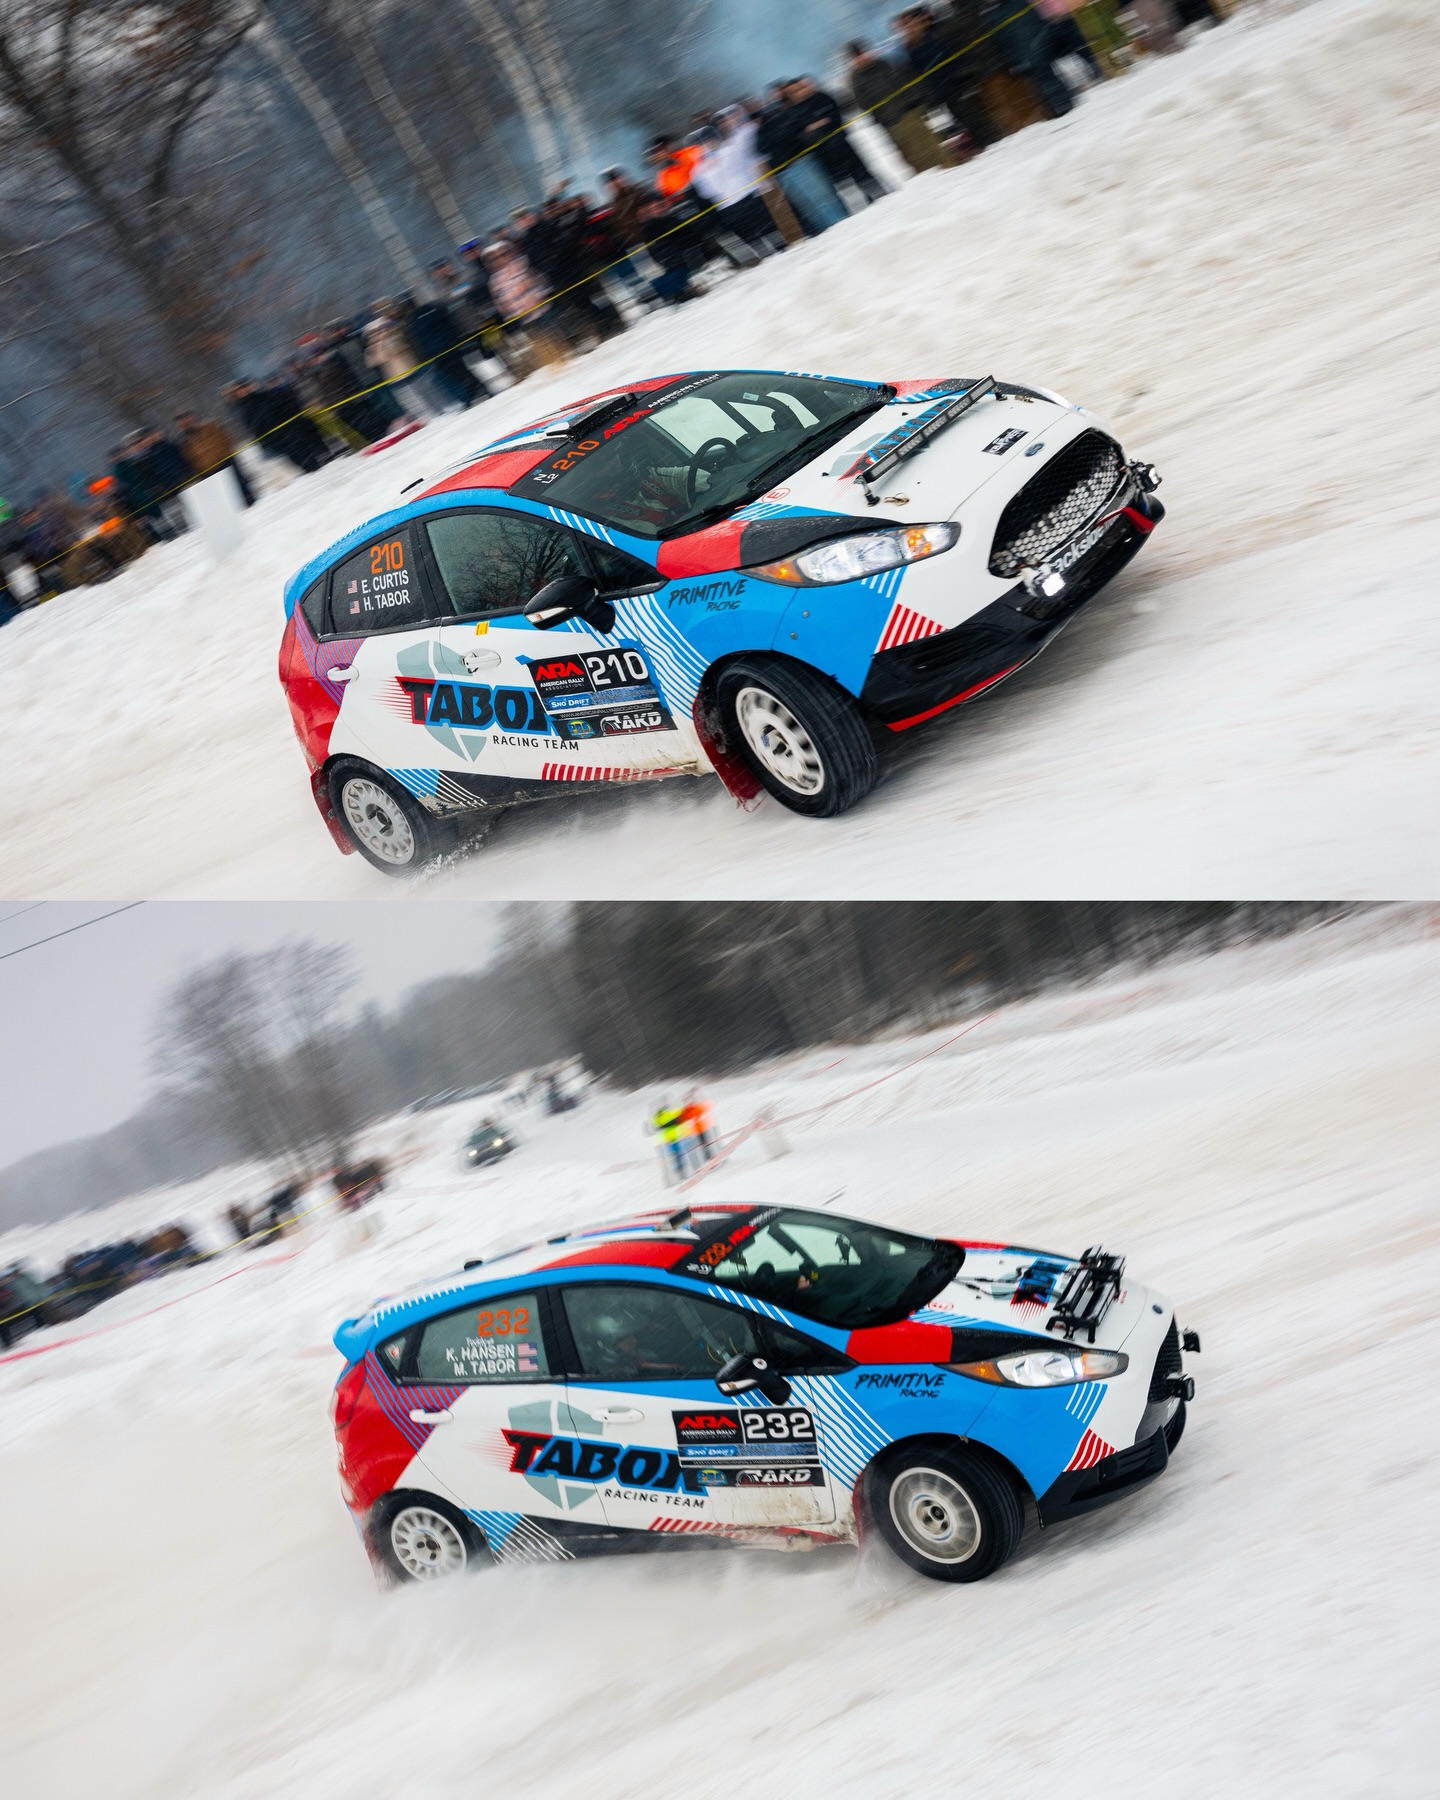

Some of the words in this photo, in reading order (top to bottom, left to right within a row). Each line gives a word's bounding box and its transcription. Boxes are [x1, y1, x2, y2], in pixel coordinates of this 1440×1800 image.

[552, 440, 600, 471] 210
[370, 541, 403, 574] 210
[361, 579, 371, 594] E.
[372, 569, 409, 592] CURTIS
[363, 596, 374, 611] H.
[375, 589, 411, 609] TABOR
[668, 579, 748, 609] PRIMITIVE
[586, 651, 649, 686] 210
[540, 679, 568, 689] AMERICAN
[568, 677, 585, 686] RALLY
[492, 735, 539, 748] RACING
[543, 739, 579, 751] TEAM
[477, 1307, 529, 1337] 232
[445, 1347, 459, 1362] K.
[461, 1344, 515, 1362] HANSEN
[453, 1361, 468, 1377] M.
[470, 1358, 516, 1376] TABOR
[854, 1373, 947, 1390] PRIMITIVE
[744, 1413, 813, 1439] 232
[604, 1488, 658, 1504] RACING
[665, 1495, 705, 1509] TEAM
